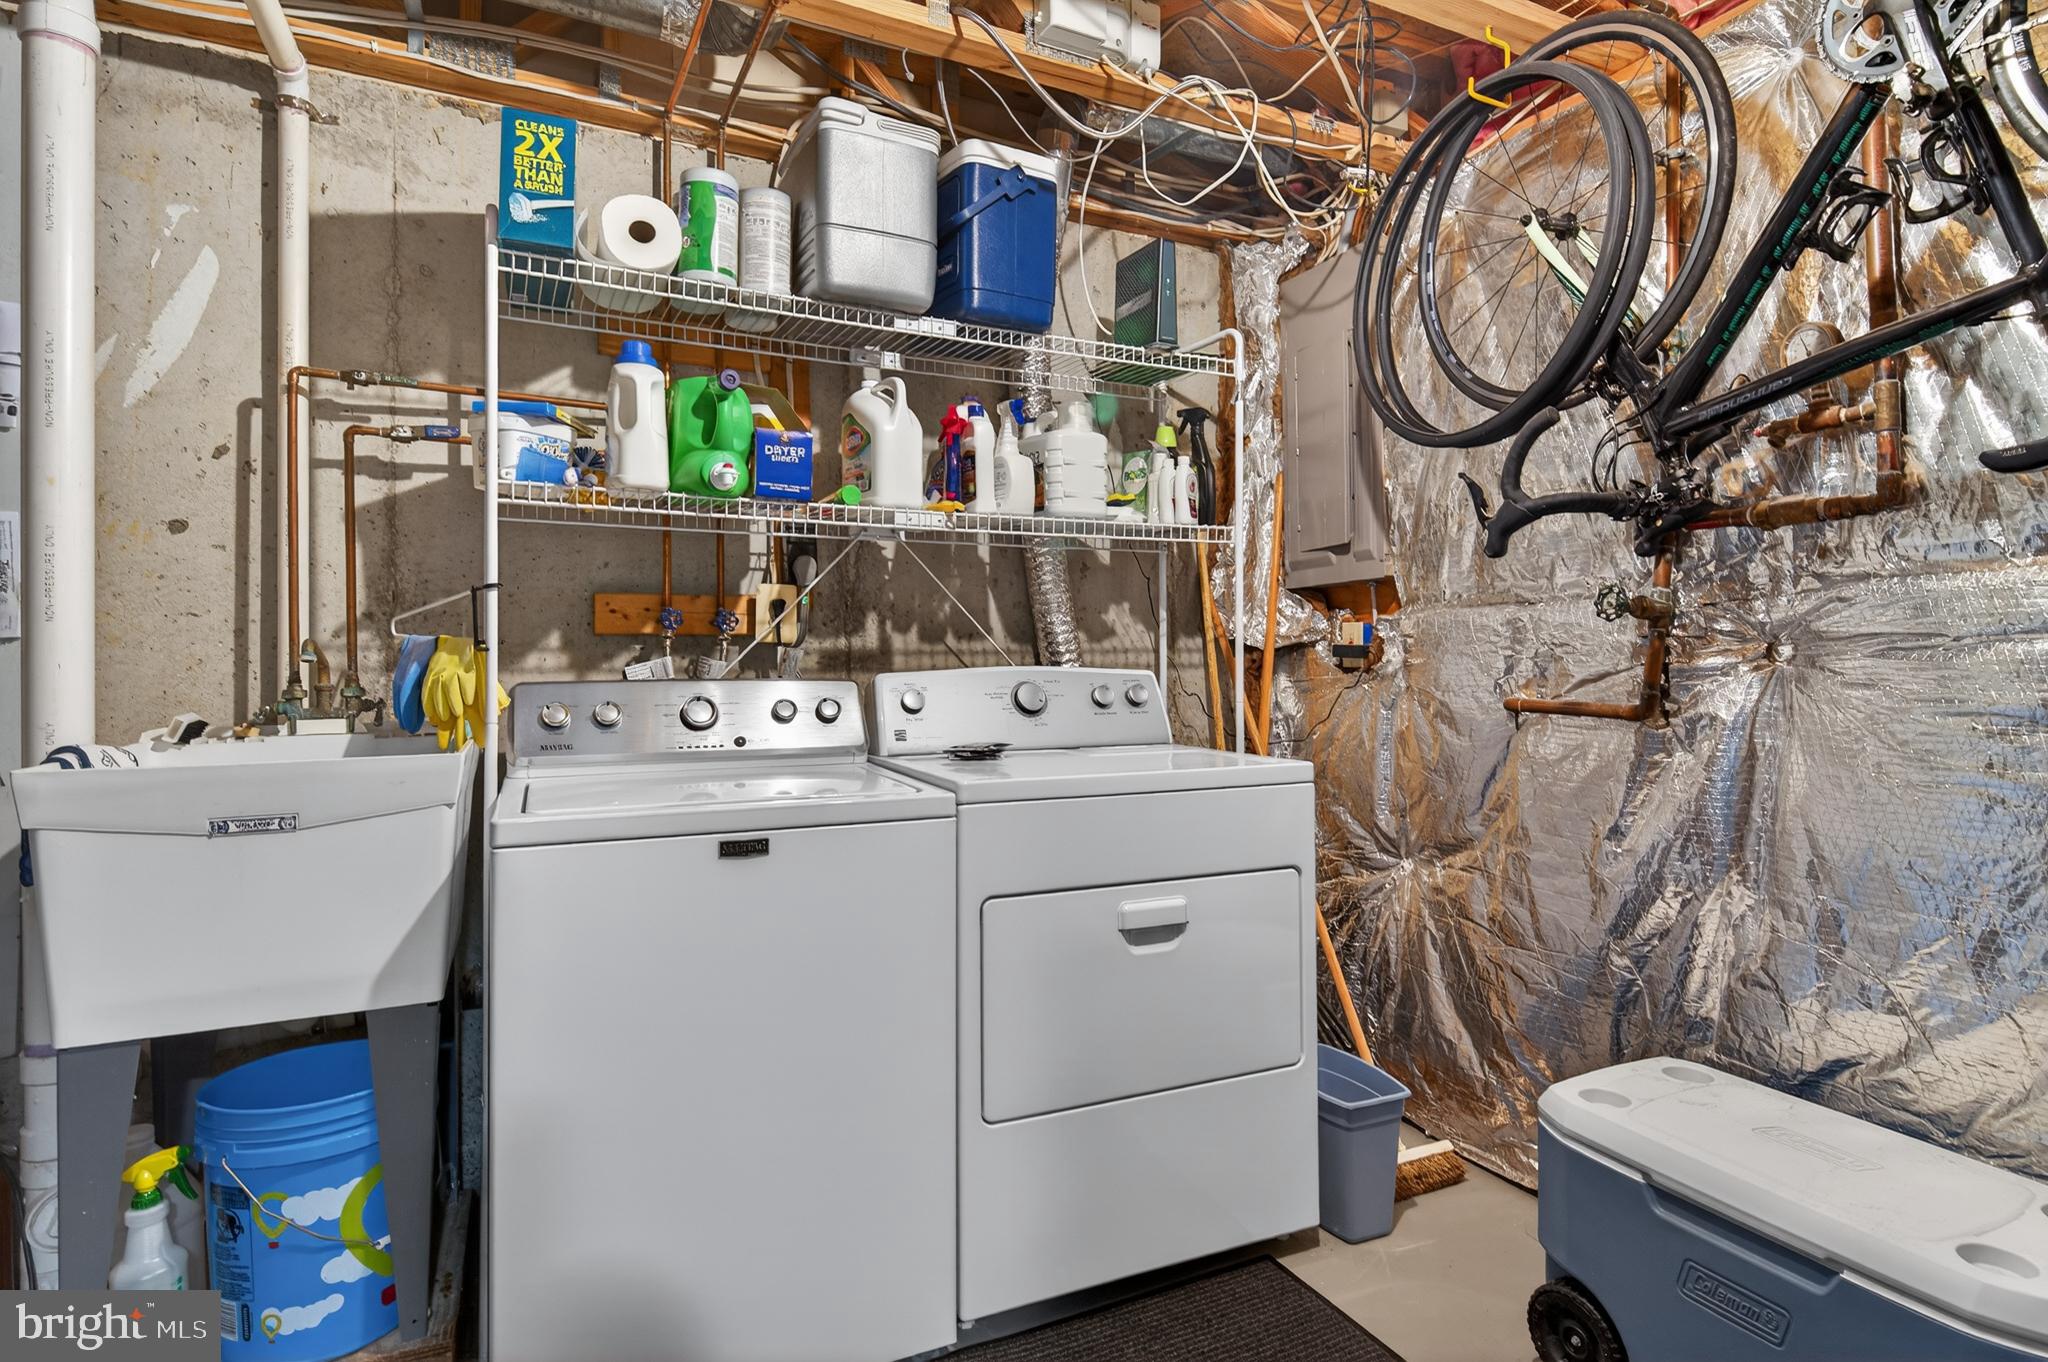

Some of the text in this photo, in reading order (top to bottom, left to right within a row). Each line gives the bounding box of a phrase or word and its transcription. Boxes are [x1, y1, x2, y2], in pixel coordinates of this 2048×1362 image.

[514, 119, 564, 137] CLEANS
[45, 134, 55, 159] ONLY
[514, 130, 564, 163] 2X
[514, 155, 564, 173] BETTER
[513, 165, 563, 187] THAN
[514, 179, 564, 196] A BRUSH
[44, 329, 54, 429] NON-PRESSURE ONLY
[765, 445, 806, 458] DRYER
[44, 523, 55, 623] NON-PRESSURE ONLY
[1693, 1271, 1761, 1324] Coleman
